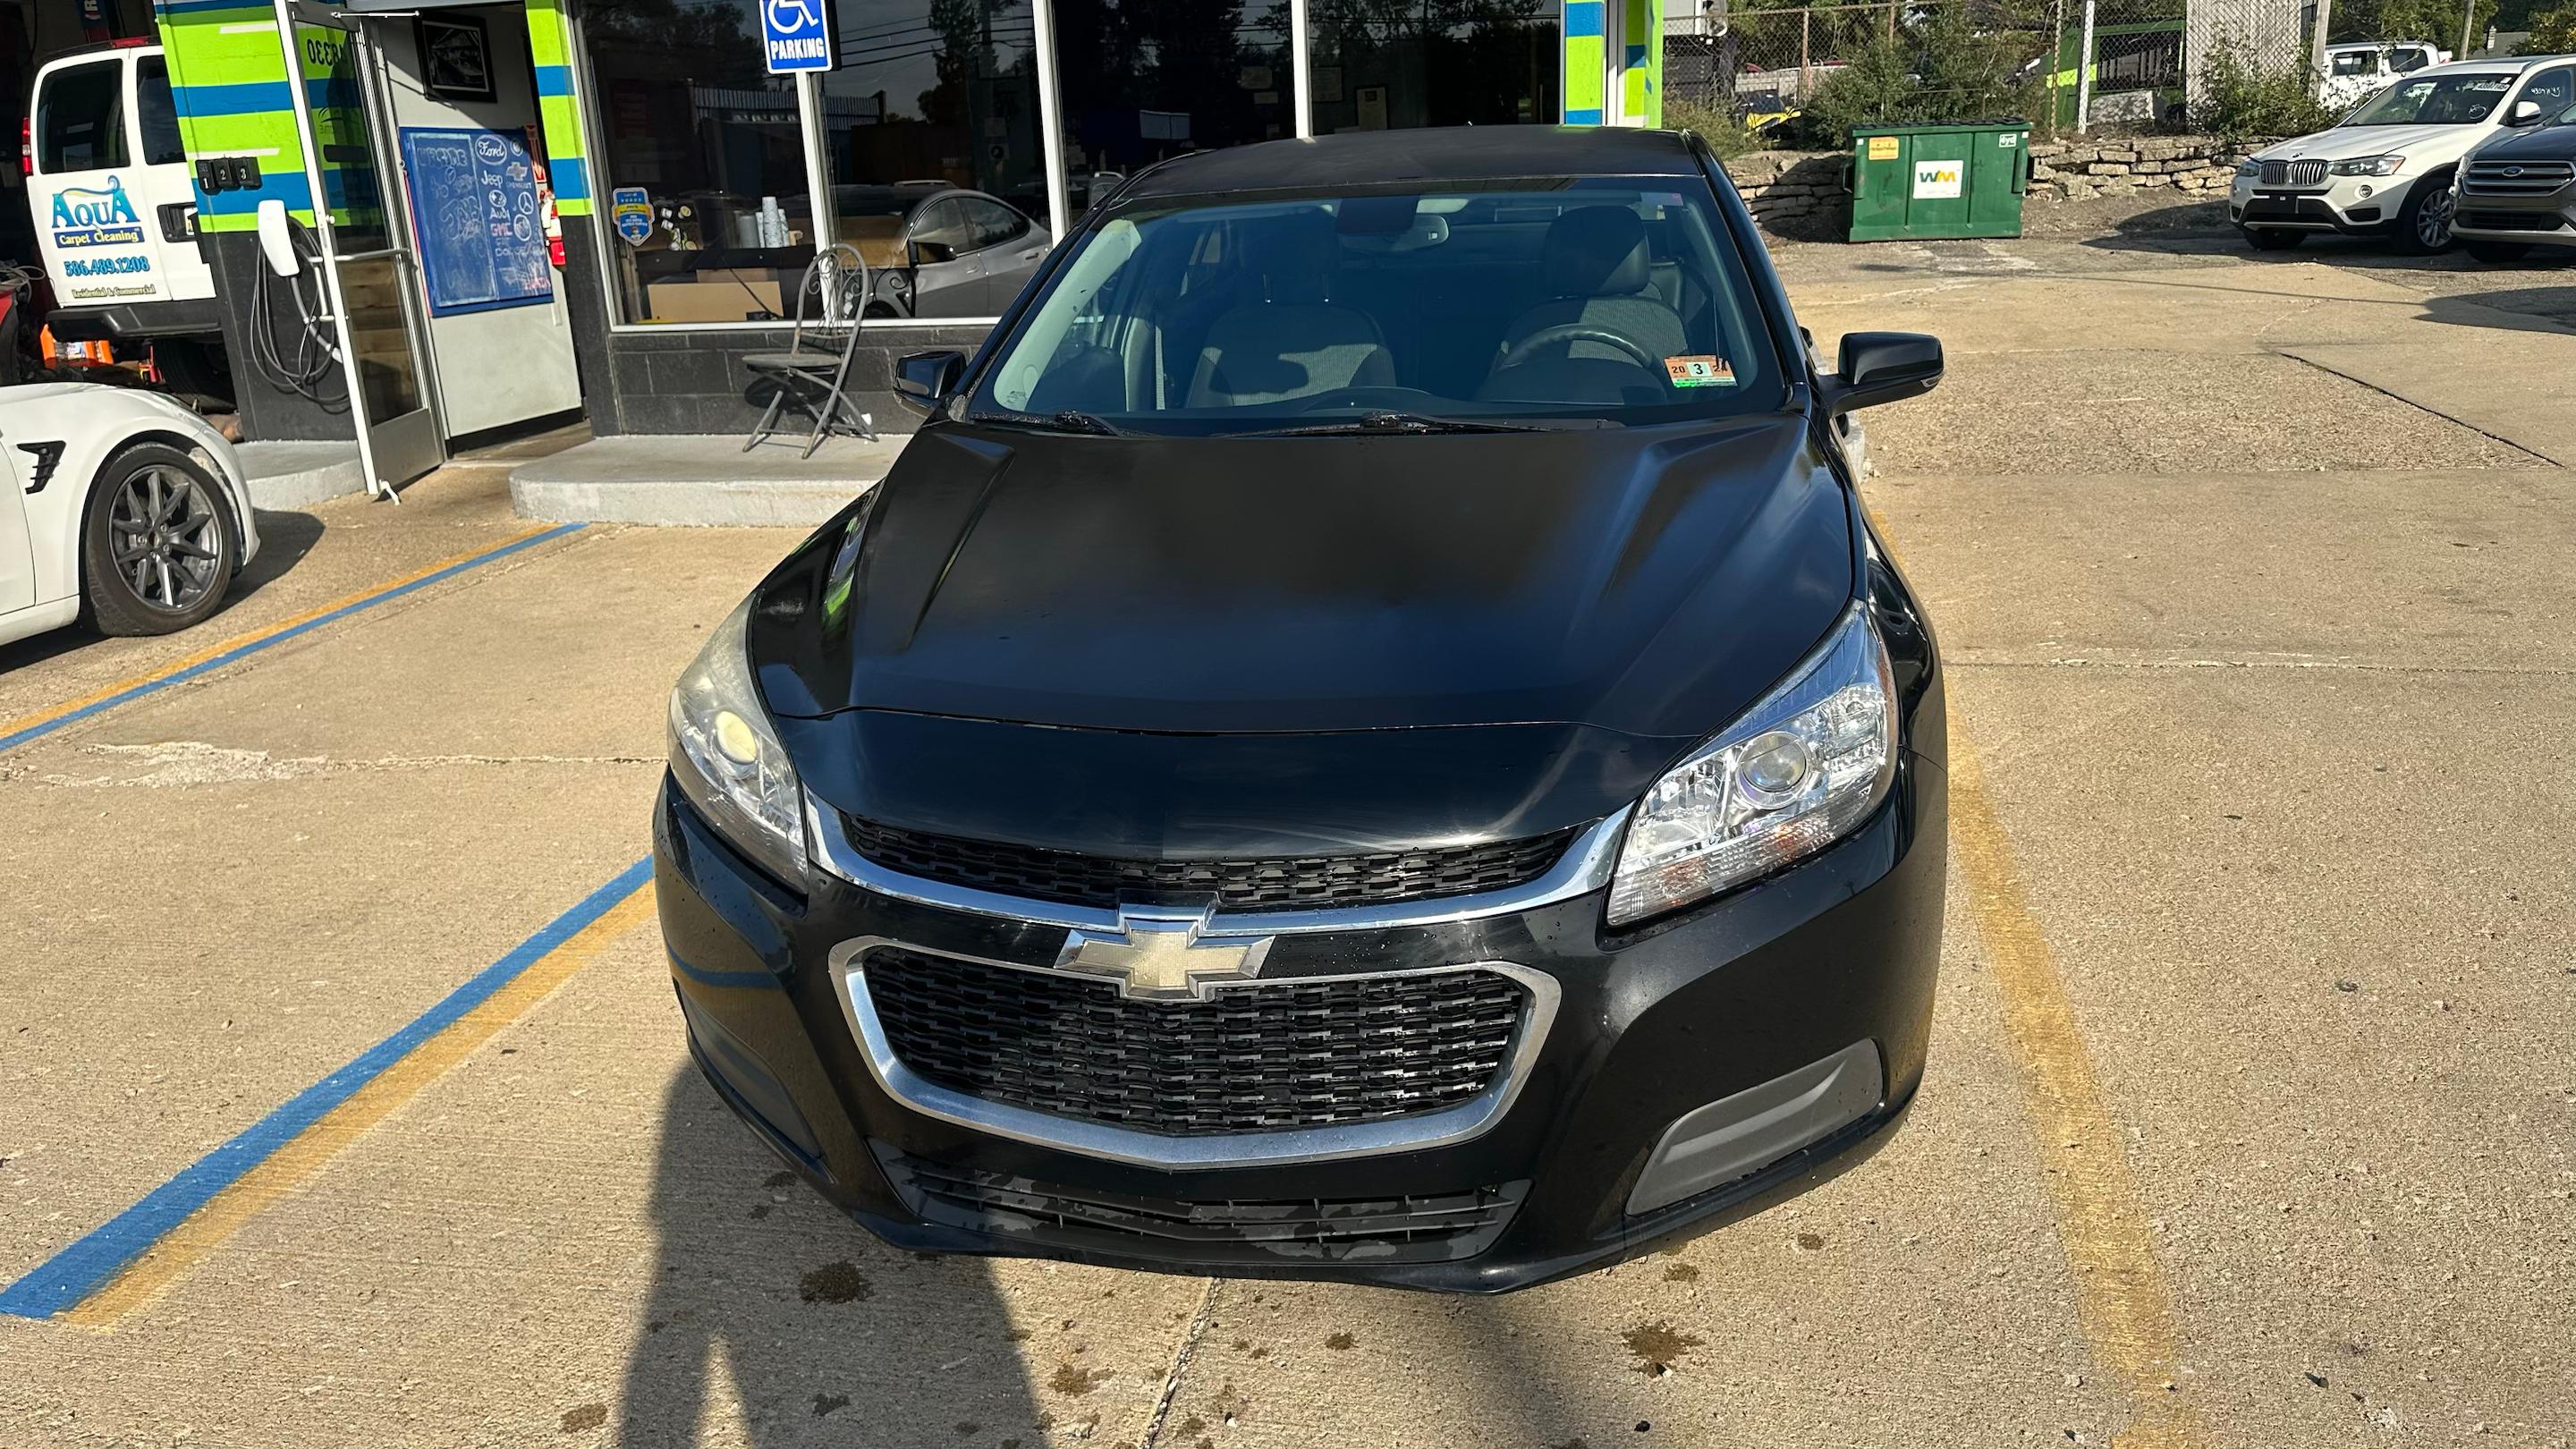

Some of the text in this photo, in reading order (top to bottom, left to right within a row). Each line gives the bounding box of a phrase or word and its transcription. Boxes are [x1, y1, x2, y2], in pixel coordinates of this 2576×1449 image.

[770, 38, 825, 60] PARKING
[479, 140, 504, 157] Ford
[220, 169, 226, 181] 2
[240, 168, 247, 180] 3
[481, 170, 503, 189] Jeep
[1919, 170, 1956, 183] WM
[203, 177, 209, 190] 1
[490, 223, 513, 237] GMC
[59, 230, 139, 247] Carpet Cleaning
[64, 256, 151, 277] 586.489.1208
[1671, 365, 1686, 374] 20
[1693, 363, 1704, 375] 3
